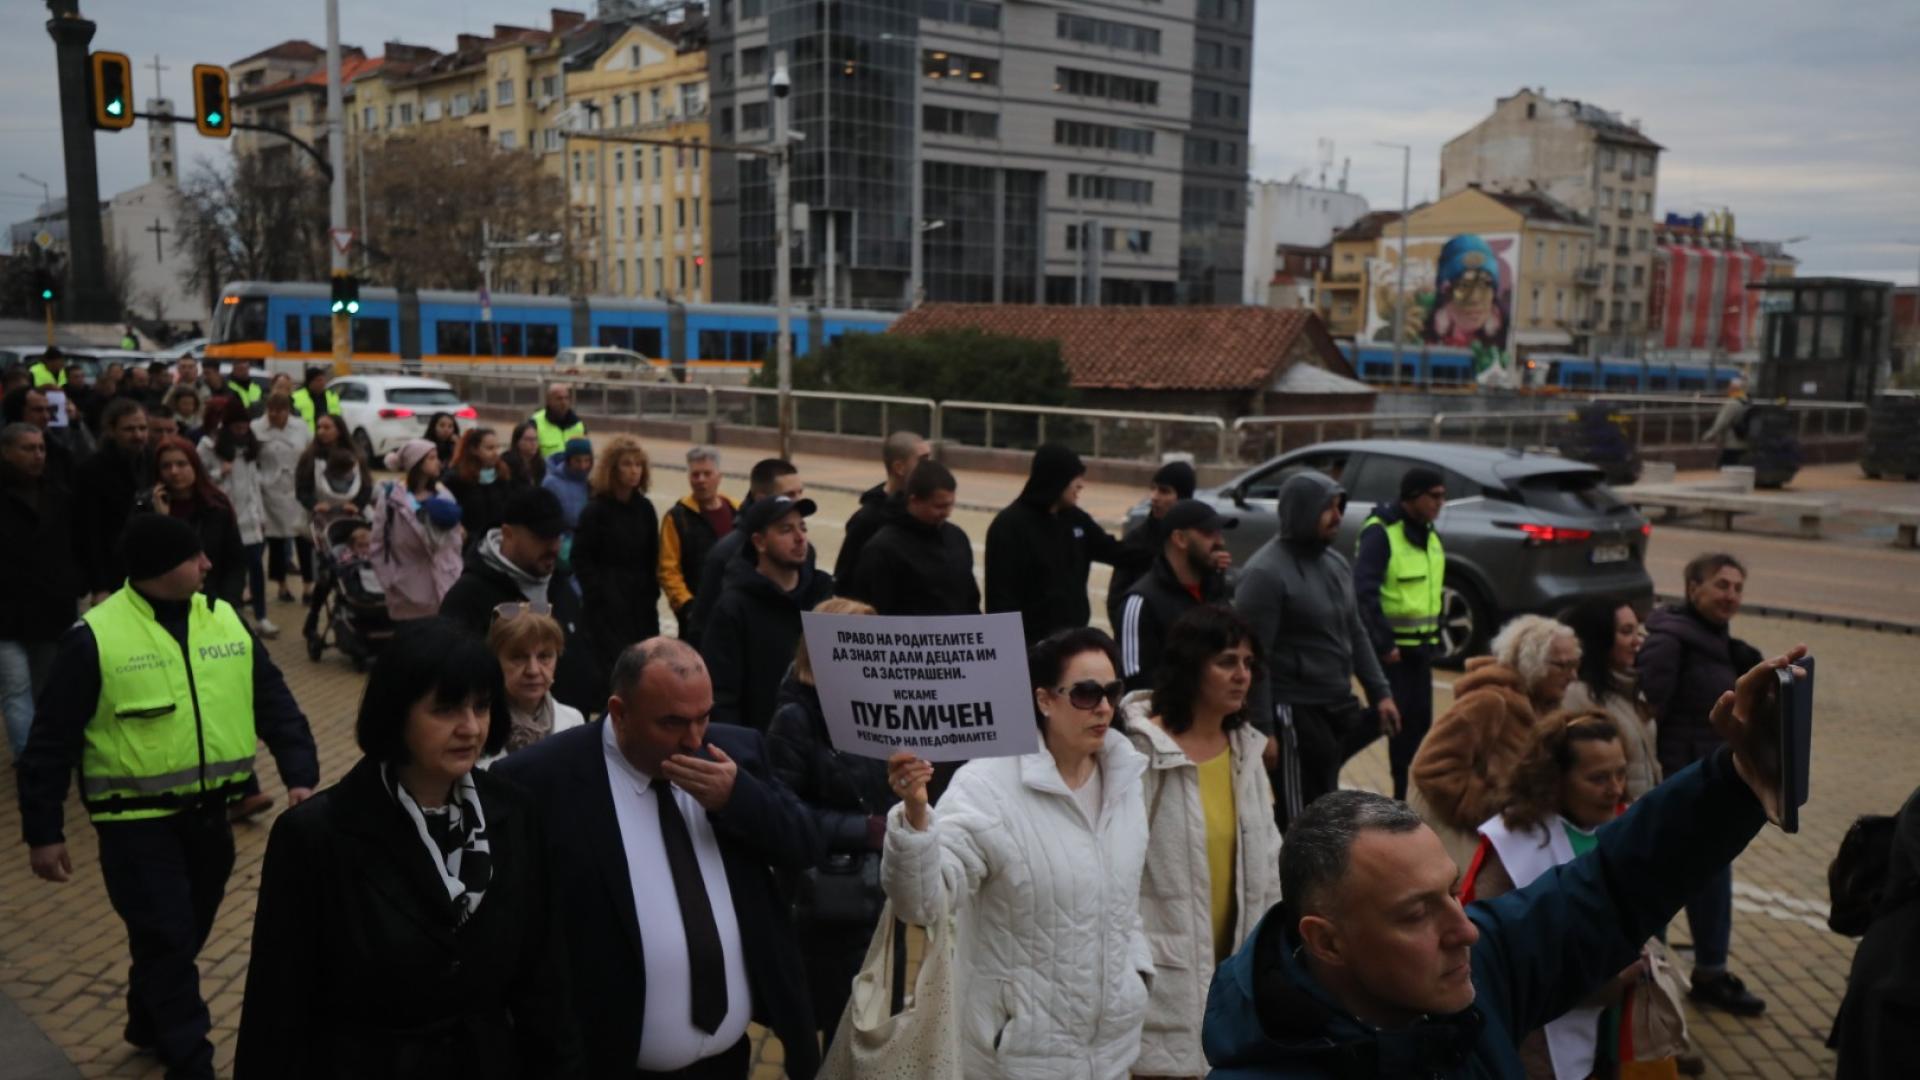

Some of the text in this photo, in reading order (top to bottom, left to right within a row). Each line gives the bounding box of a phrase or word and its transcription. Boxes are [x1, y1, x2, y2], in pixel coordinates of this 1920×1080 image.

[837, 631, 984, 648] ПРАВО НА РОДИТЕЛИТЕ Е
[199, 641, 246, 661] POLICE
[832, 648, 997, 665] ДА ЗНАЯТ ДАЛИ ДЕЦАТА ИМ
[862, 666, 967, 680] СА ЗАСТРАШЕНИ.
[893, 689, 938, 700] ИСКАМЕ
[851, 701, 994, 731] ПУБЛИЧЕН
[856, 730, 997, 747] РЕГИСТЪР НА ПЕДОФИЛИТЕ!
